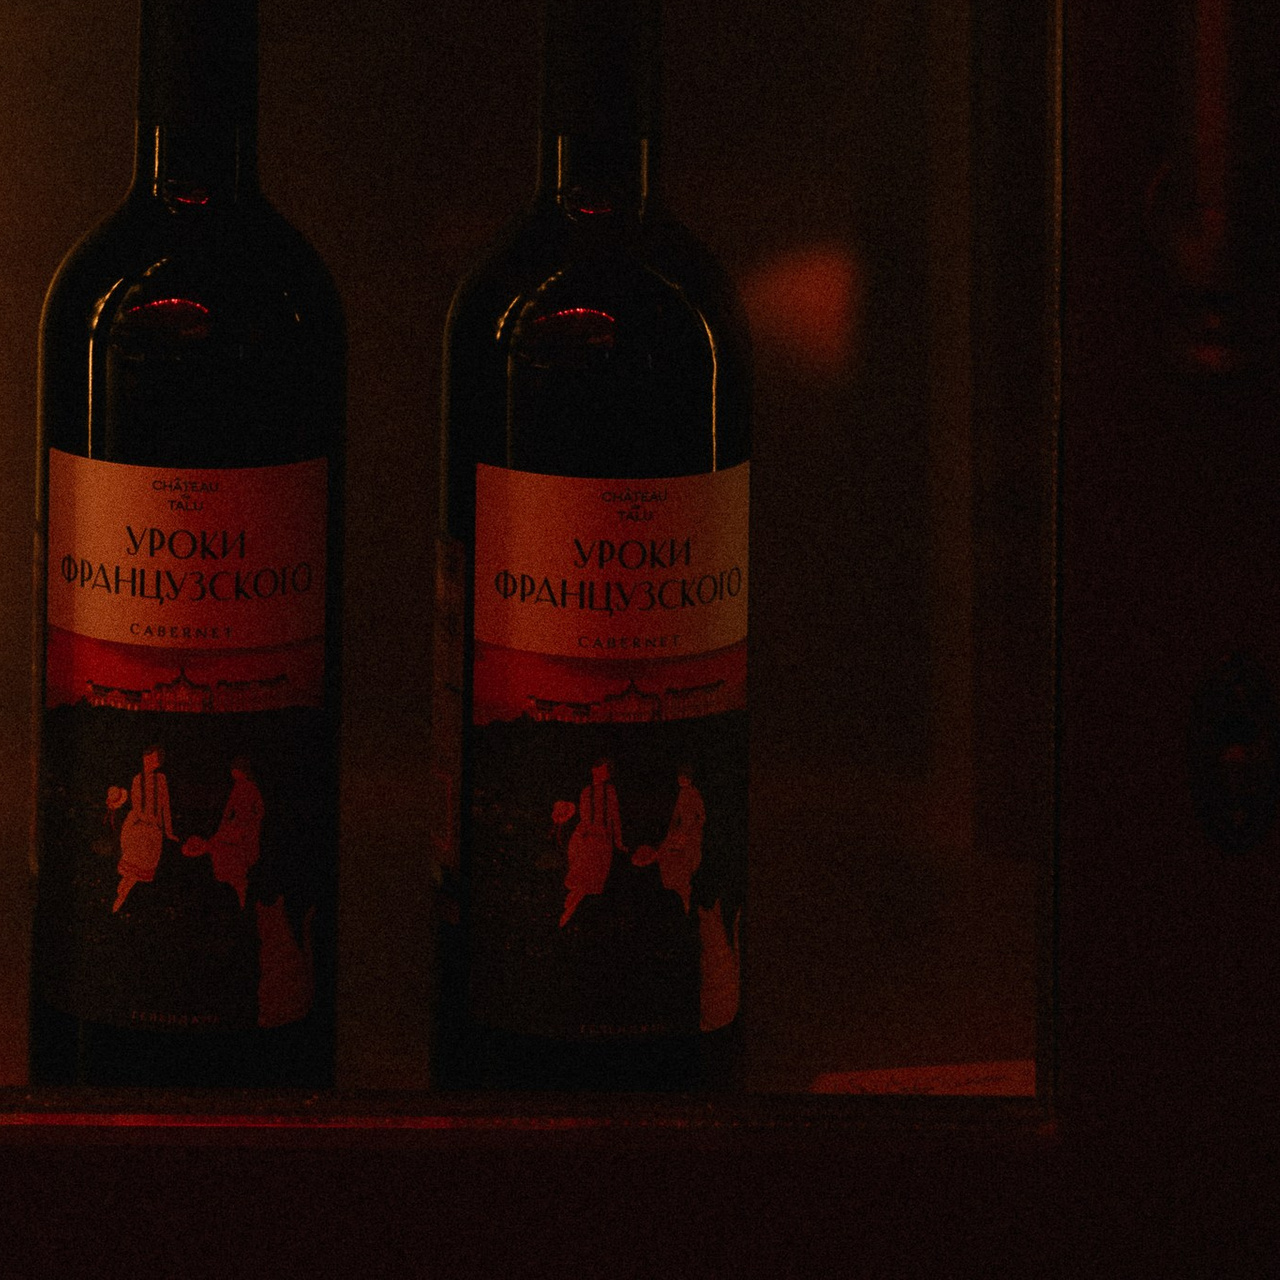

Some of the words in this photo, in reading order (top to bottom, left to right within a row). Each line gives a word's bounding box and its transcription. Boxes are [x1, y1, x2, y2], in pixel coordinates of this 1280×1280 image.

[167, 499, 205, 512] TALU
[125, 524, 246, 561] УРОКИ
[572, 536, 692, 570] УРОКИ
[60, 553, 312, 605] ФРАНЦУЗСКОГО
[493, 566, 743, 617] ФРАНЦУЗСКОГО
[129, 622, 234, 639] CABERNET
